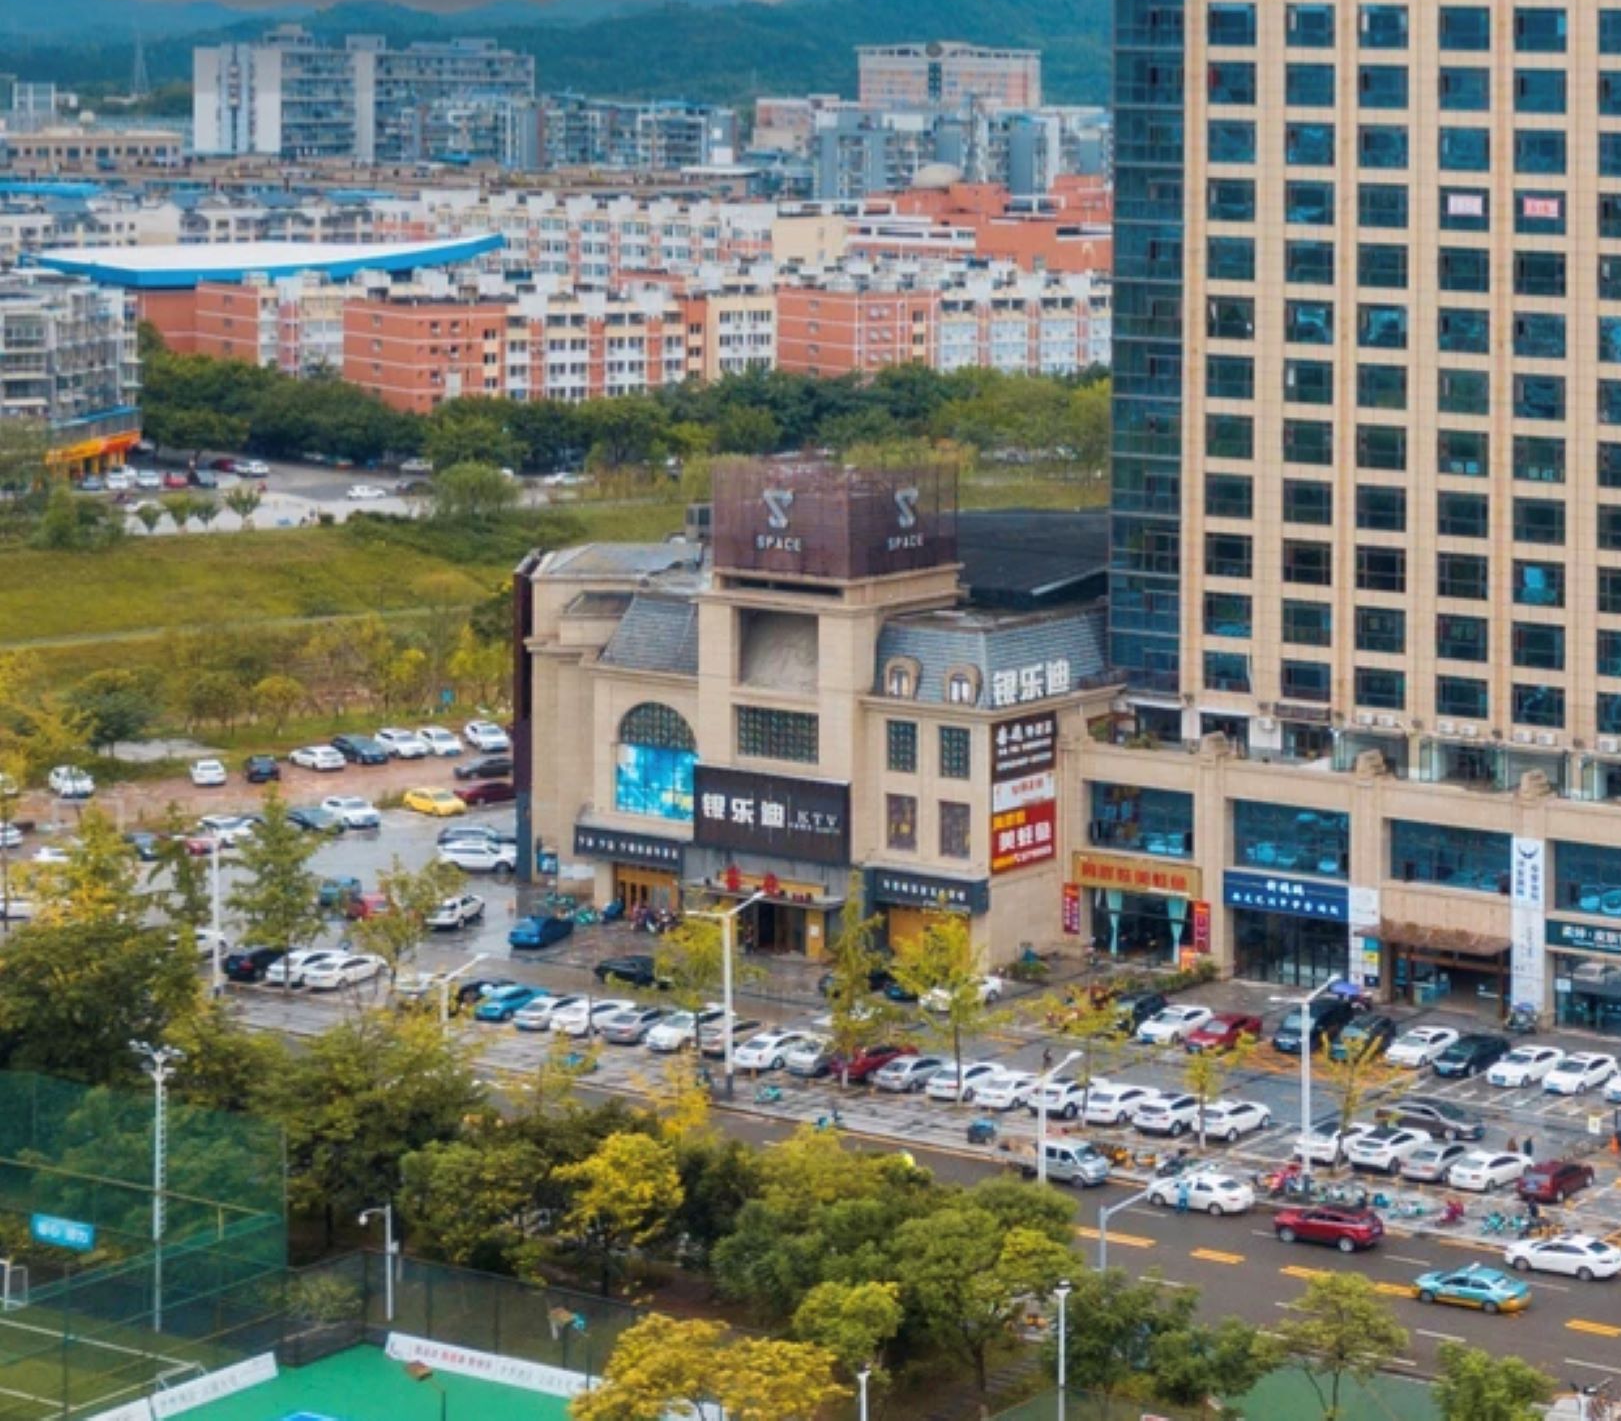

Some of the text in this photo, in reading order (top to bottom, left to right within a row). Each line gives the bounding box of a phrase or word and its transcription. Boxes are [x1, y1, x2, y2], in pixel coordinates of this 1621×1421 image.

[756, 534, 801, 552] SPACE
[887, 532, 924, 552] SPACE
[797, 810, 838, 828] KTV
